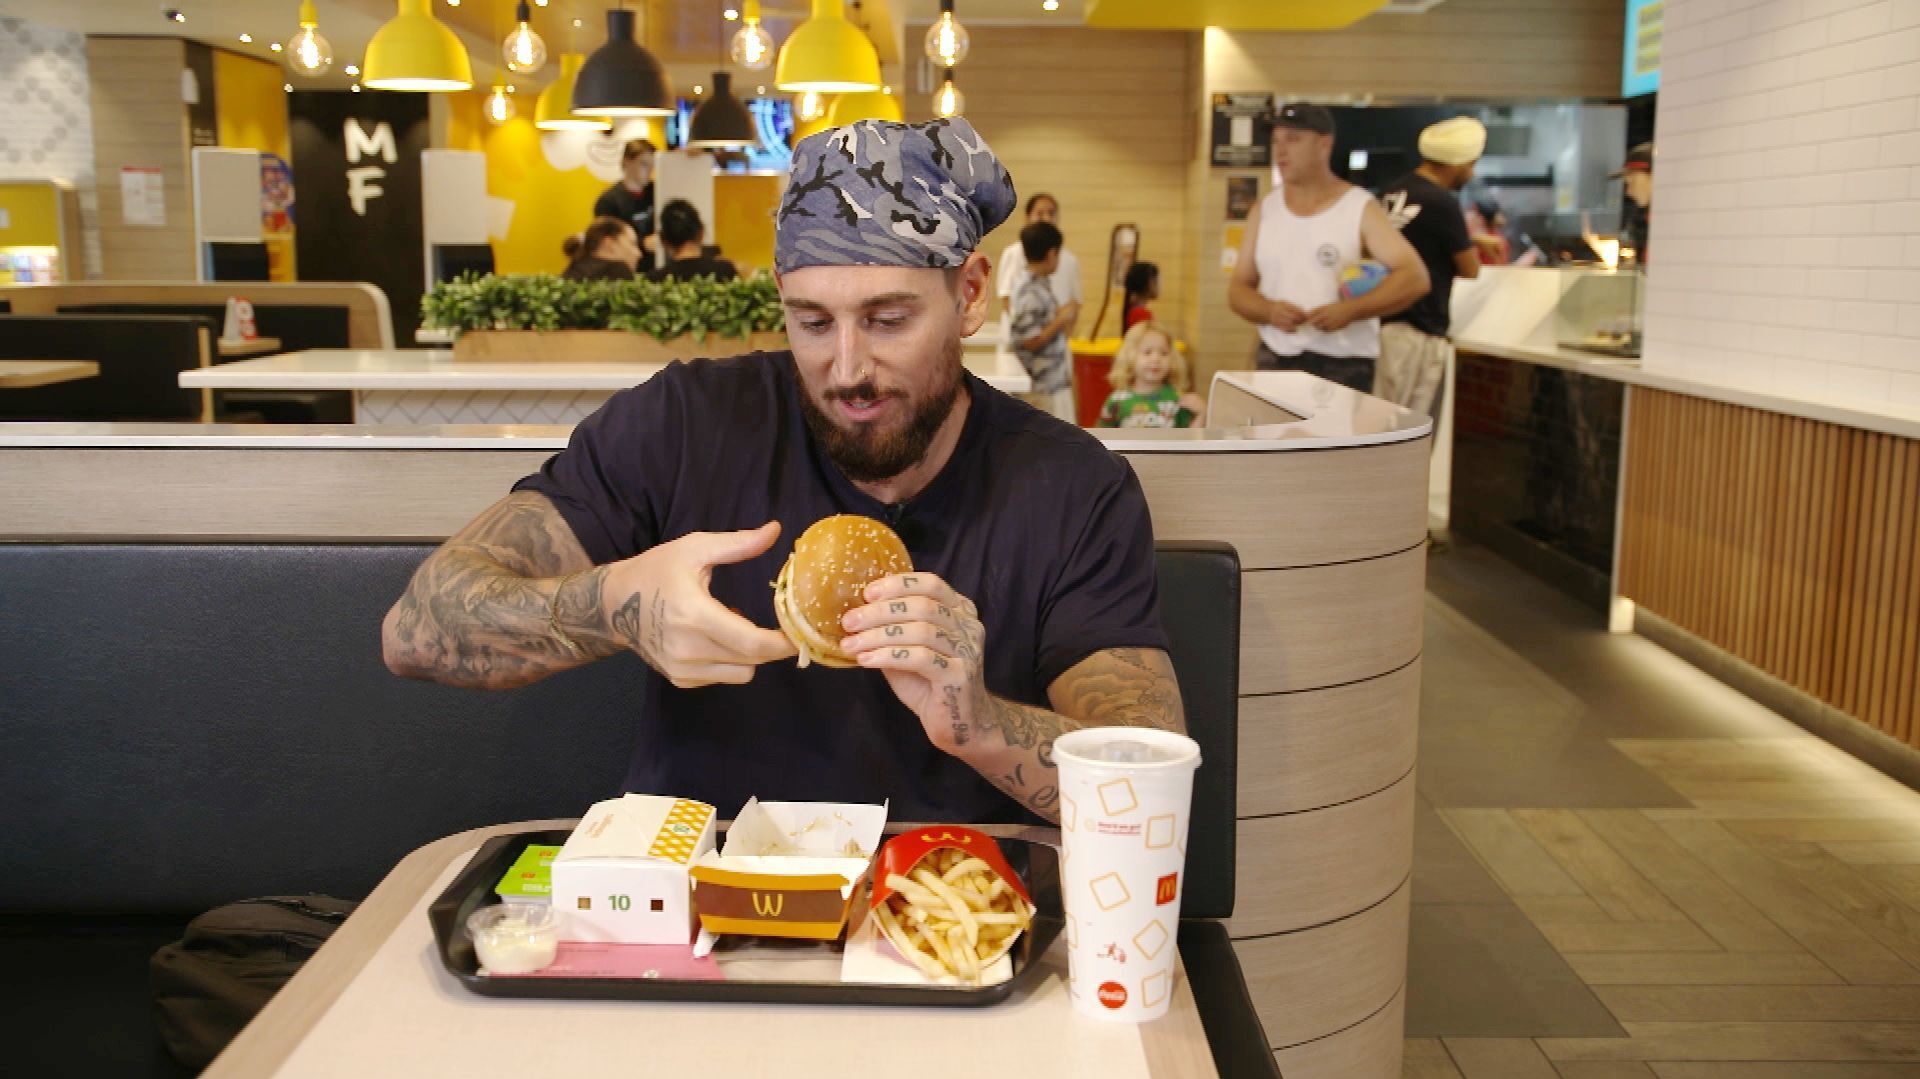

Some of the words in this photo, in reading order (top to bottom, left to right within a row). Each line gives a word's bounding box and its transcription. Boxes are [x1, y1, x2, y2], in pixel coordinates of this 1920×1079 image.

[343, 118, 398, 164] M
[345, 167, 386, 216] F
[608, 894, 631, 911] 10
